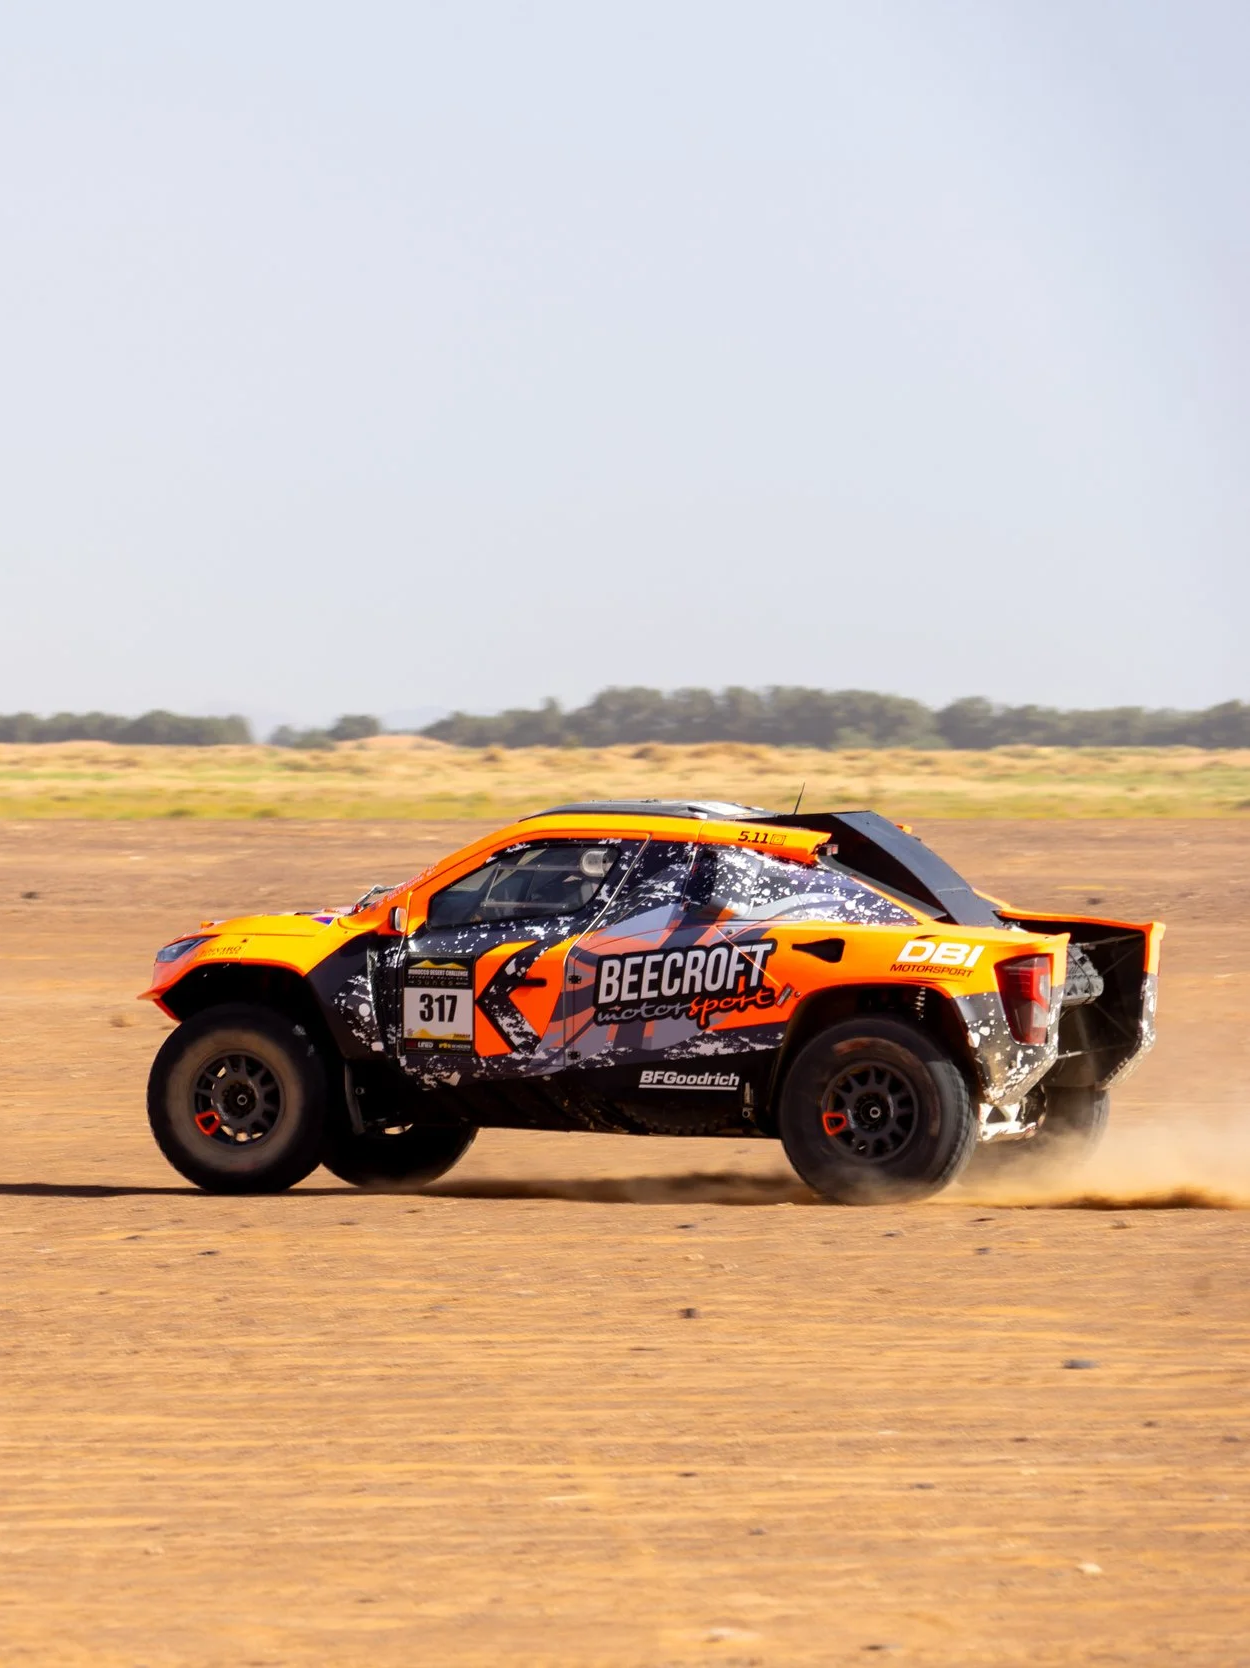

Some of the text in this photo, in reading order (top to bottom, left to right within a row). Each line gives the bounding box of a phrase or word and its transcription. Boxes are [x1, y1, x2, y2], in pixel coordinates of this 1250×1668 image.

[738, 831, 768, 844] 5.11
[896, 940, 985, 967] DBI
[598, 943, 773, 1004] BEECROFT
[890, 963, 974, 978] MOTORSPORT
[419, 993, 458, 1023] 317
[639, 1070, 740, 1087] BFGoodrich
